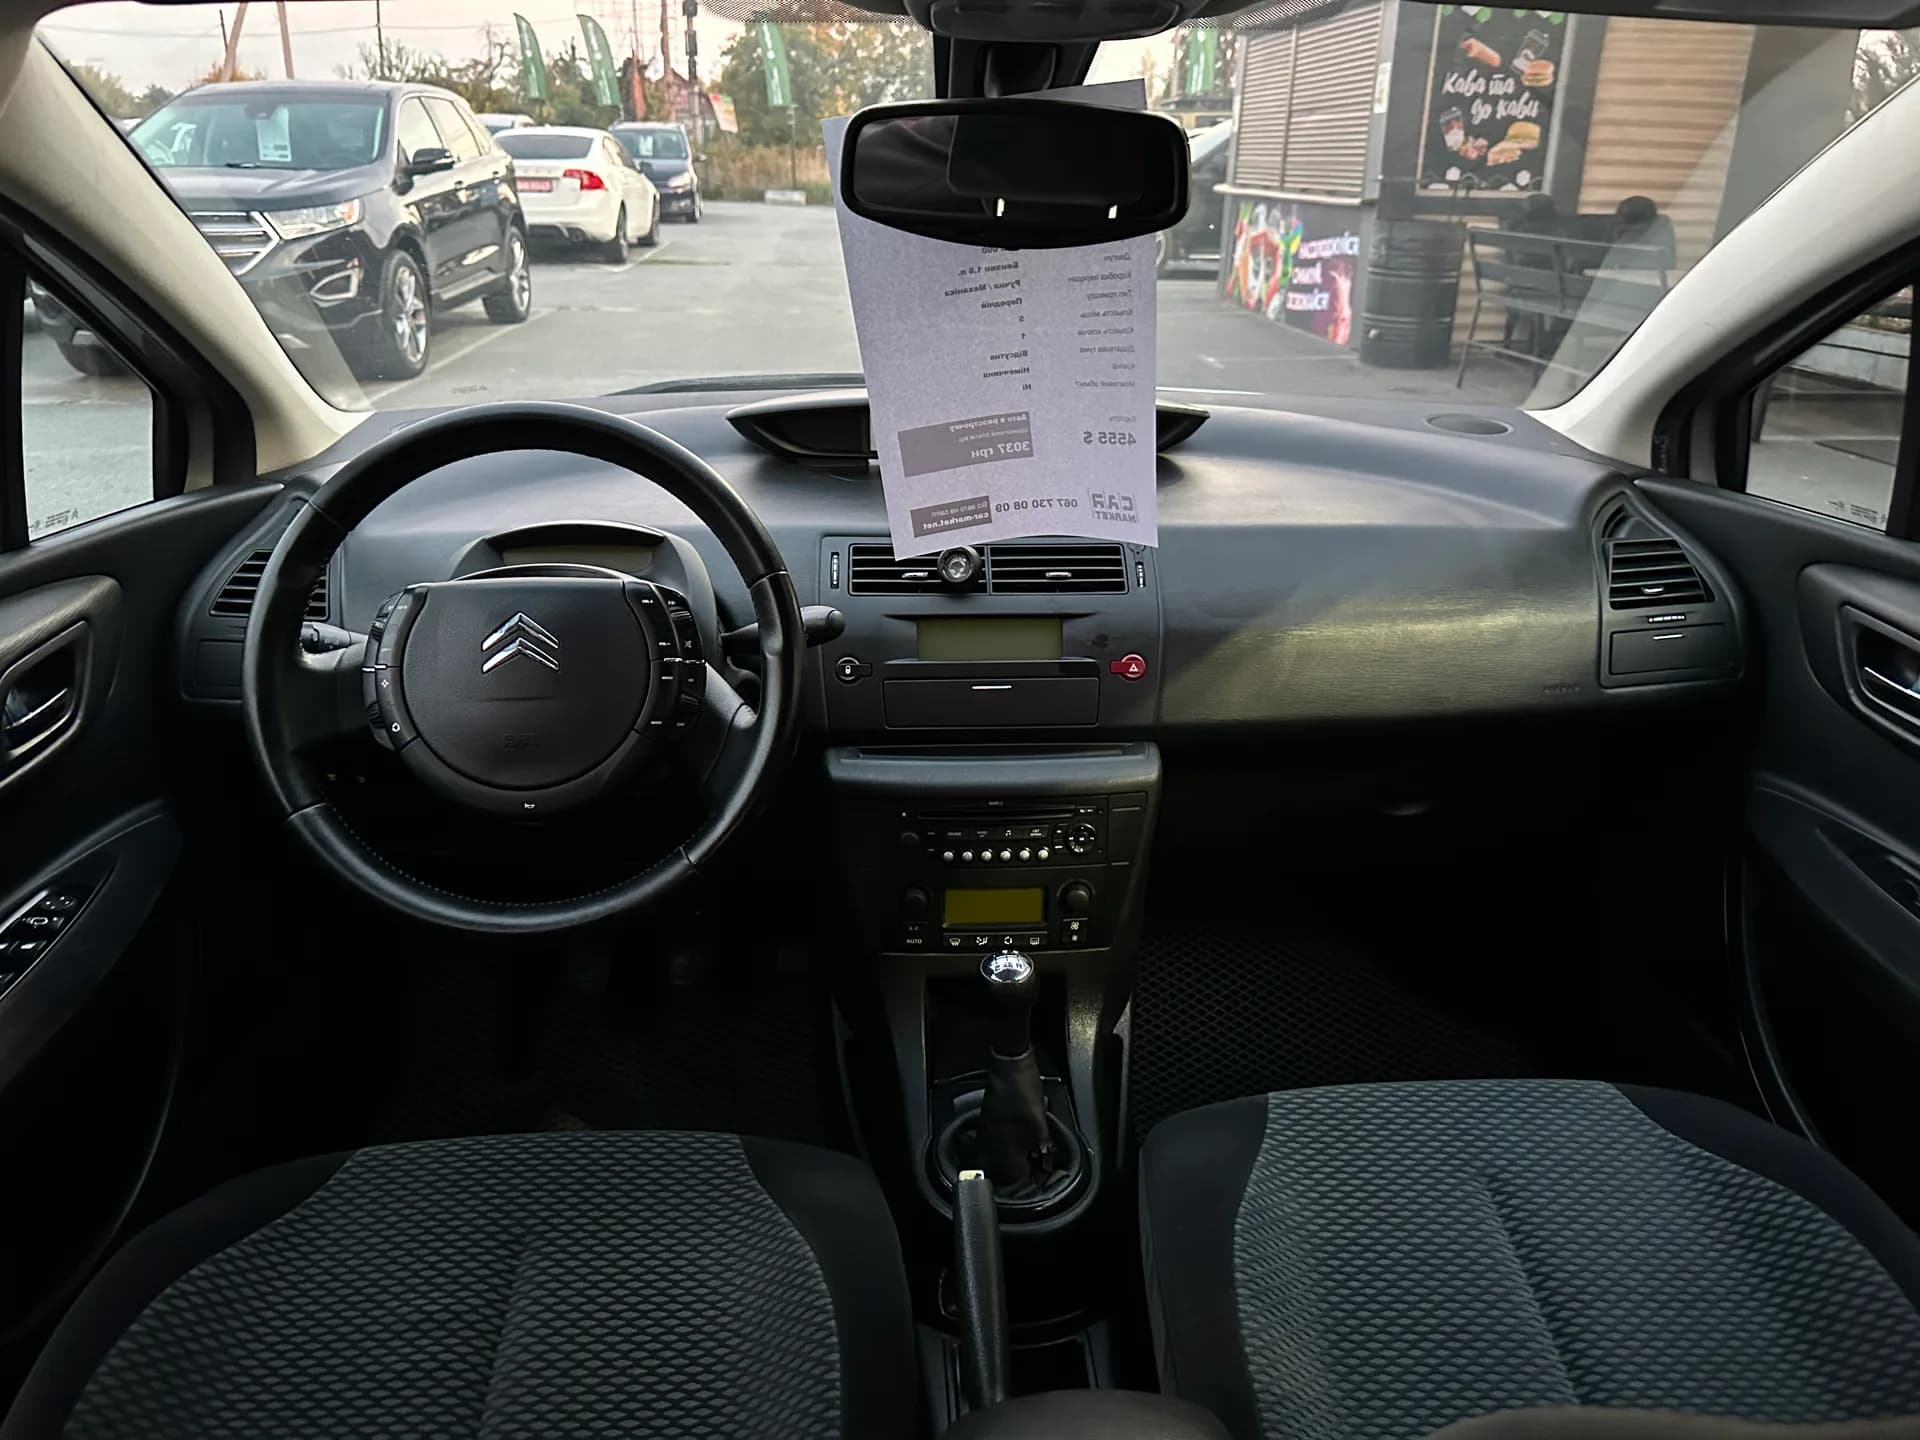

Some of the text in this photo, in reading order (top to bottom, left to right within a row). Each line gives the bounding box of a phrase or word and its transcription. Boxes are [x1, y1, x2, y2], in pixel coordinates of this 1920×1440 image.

[1442, 69, 1515, 97] Кава та
[1470, 92, 1540, 125] до кави
